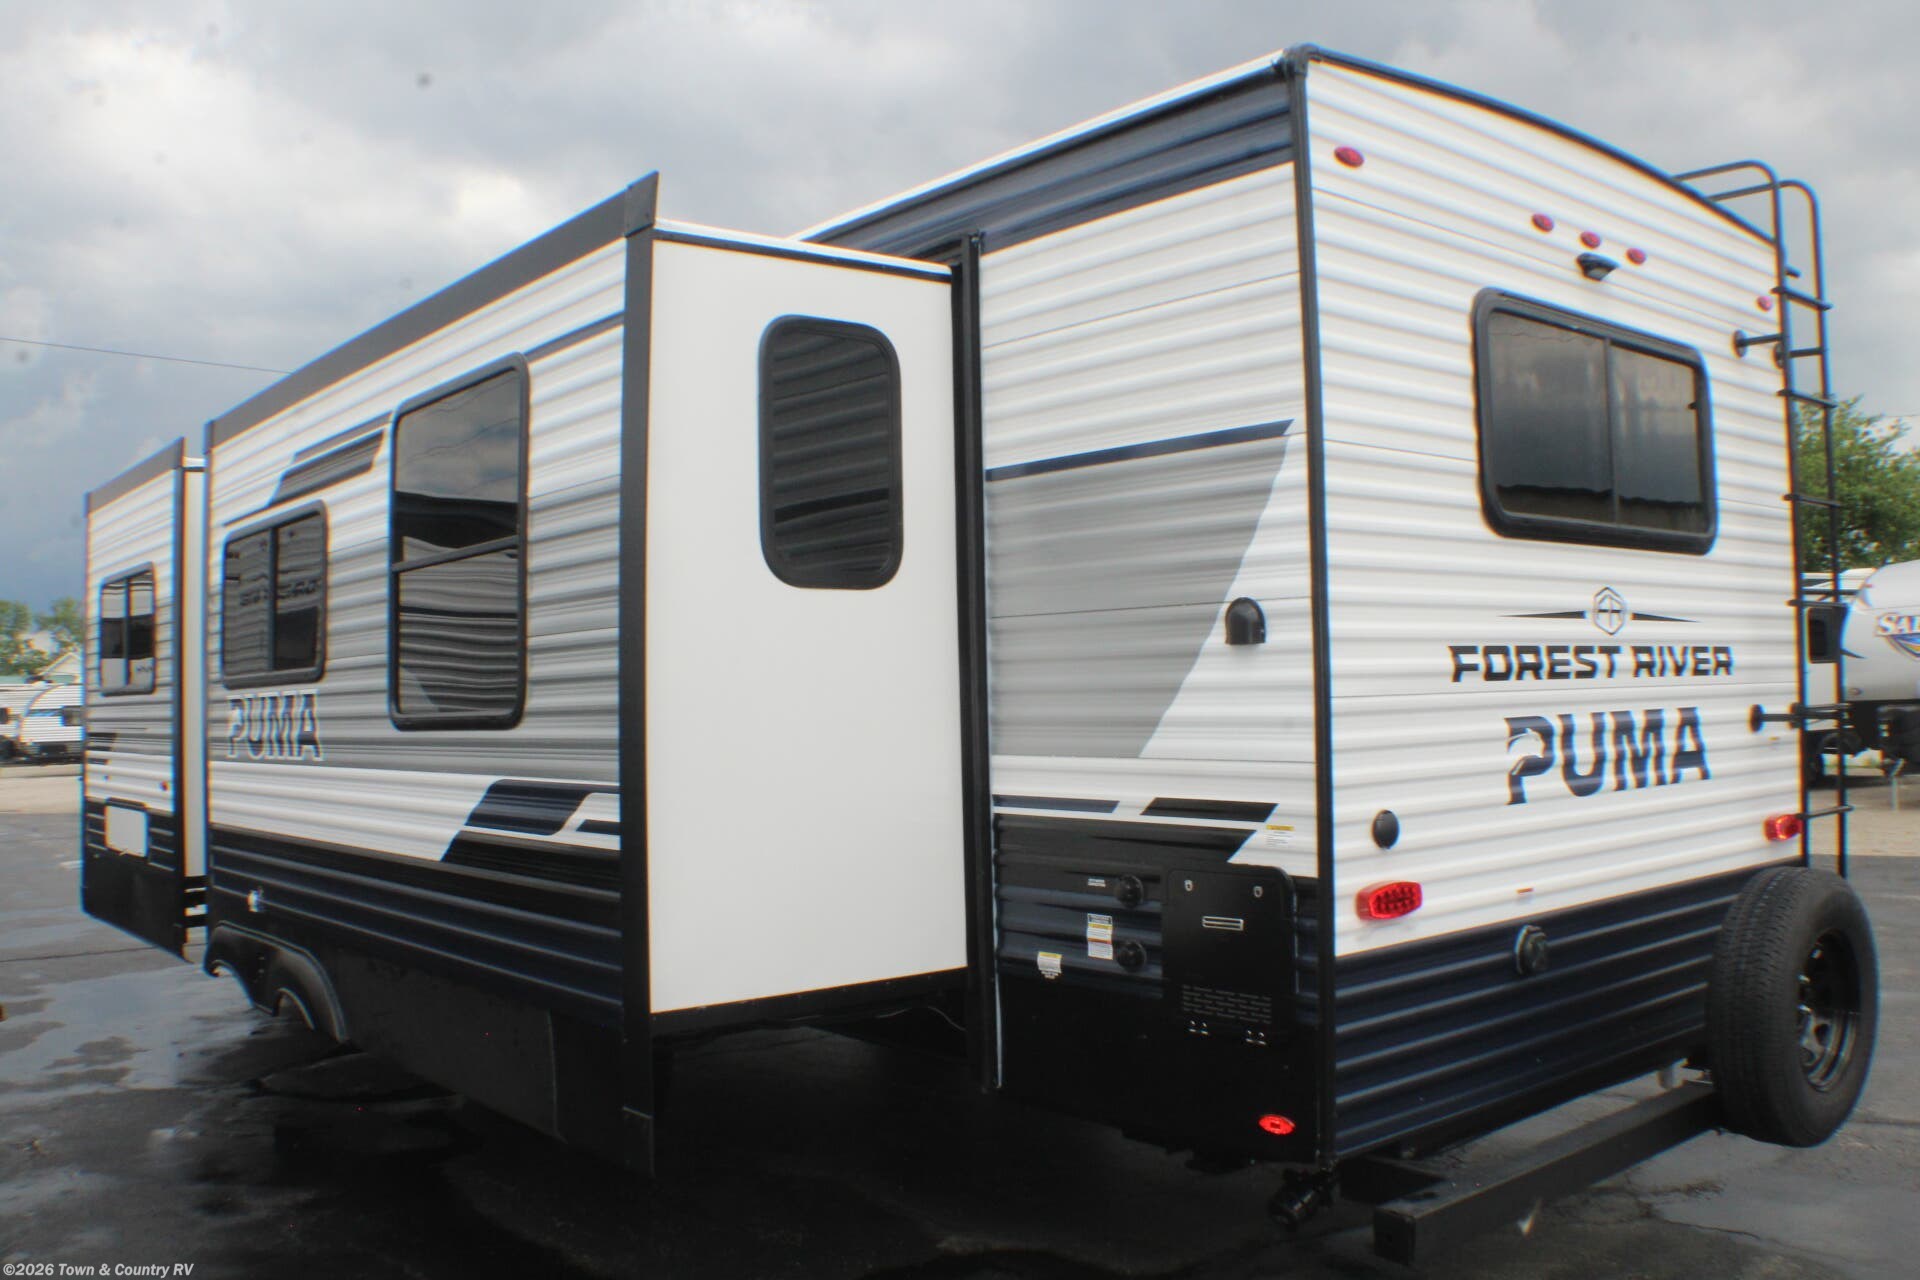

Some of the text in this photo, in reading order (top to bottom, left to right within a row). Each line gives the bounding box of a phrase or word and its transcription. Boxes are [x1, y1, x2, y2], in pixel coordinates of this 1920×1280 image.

[1448, 645, 1733, 682] FOREST RIVER
[227, 689, 323, 760] PUMA
[1503, 706, 1711, 805] PUMA
